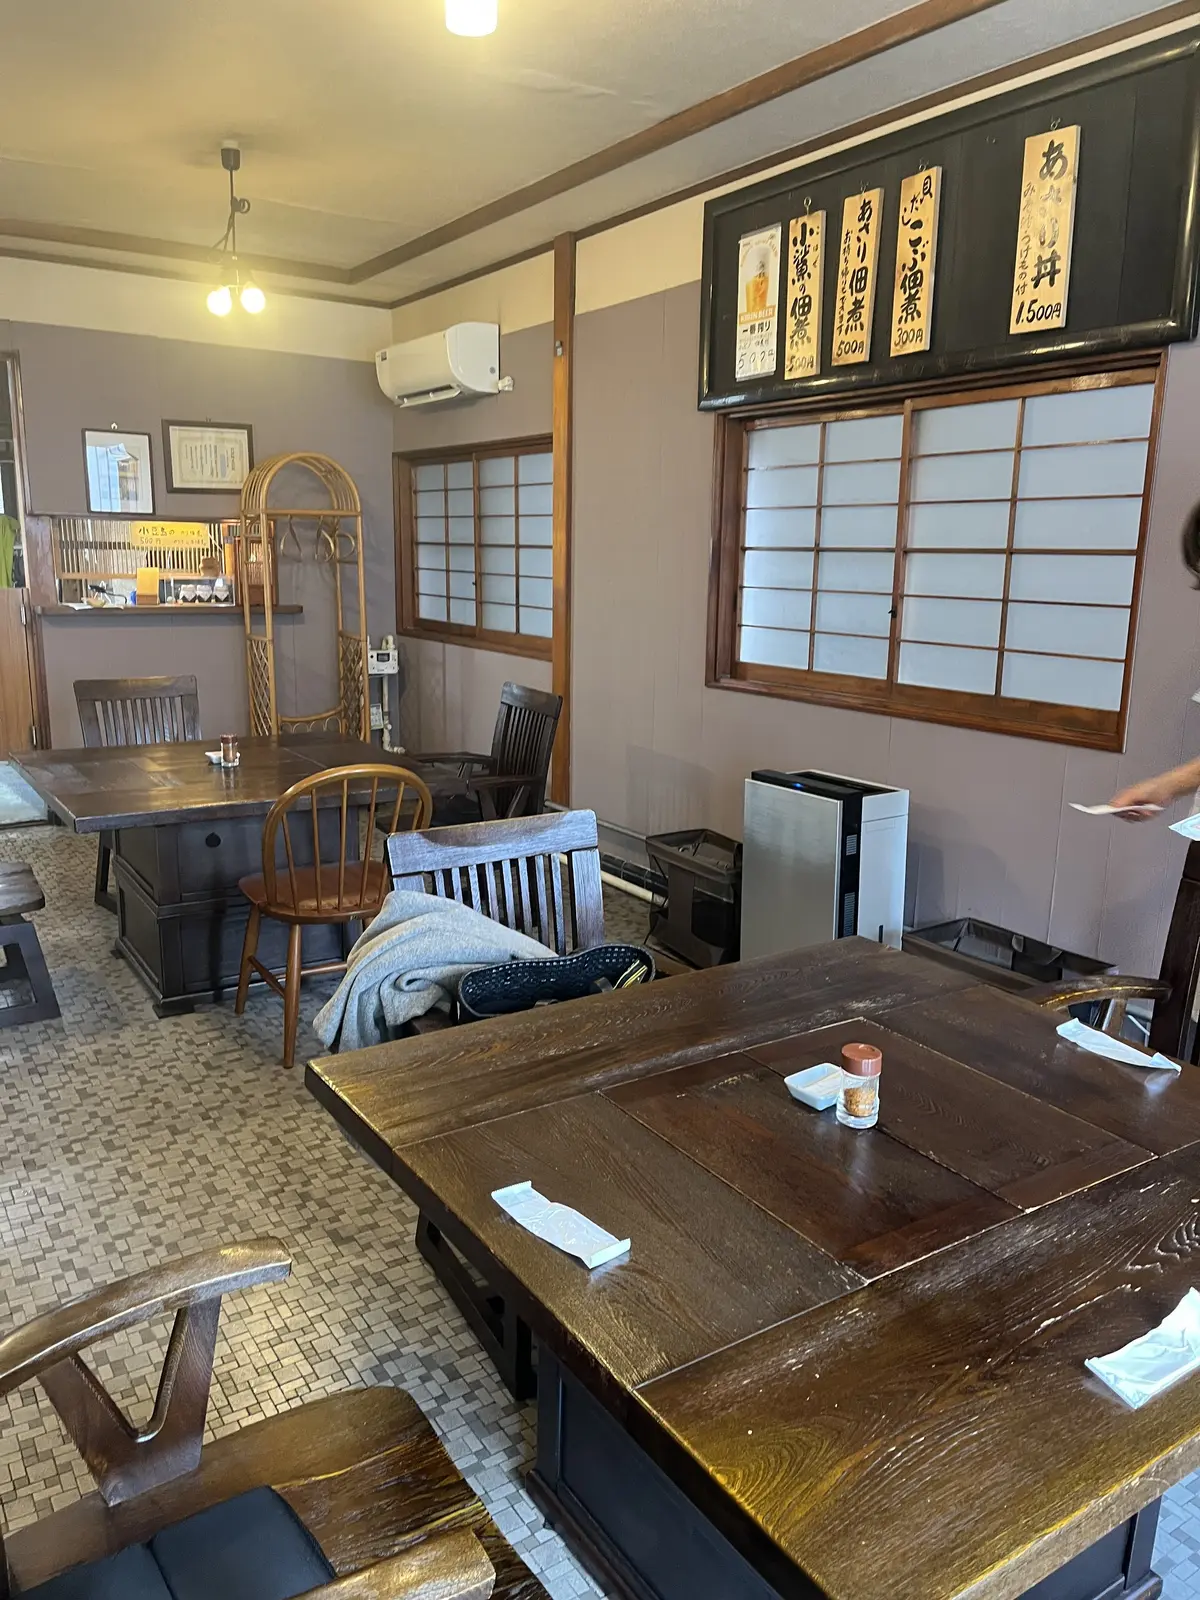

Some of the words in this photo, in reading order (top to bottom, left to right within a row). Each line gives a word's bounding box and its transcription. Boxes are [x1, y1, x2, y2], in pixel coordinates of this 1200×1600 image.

[845, 198, 873, 336] あさり佃煮
[894, 327, 923, 347] 300円
[836, 340, 864, 357] 500円
[785, 355, 814, 372] 500円
